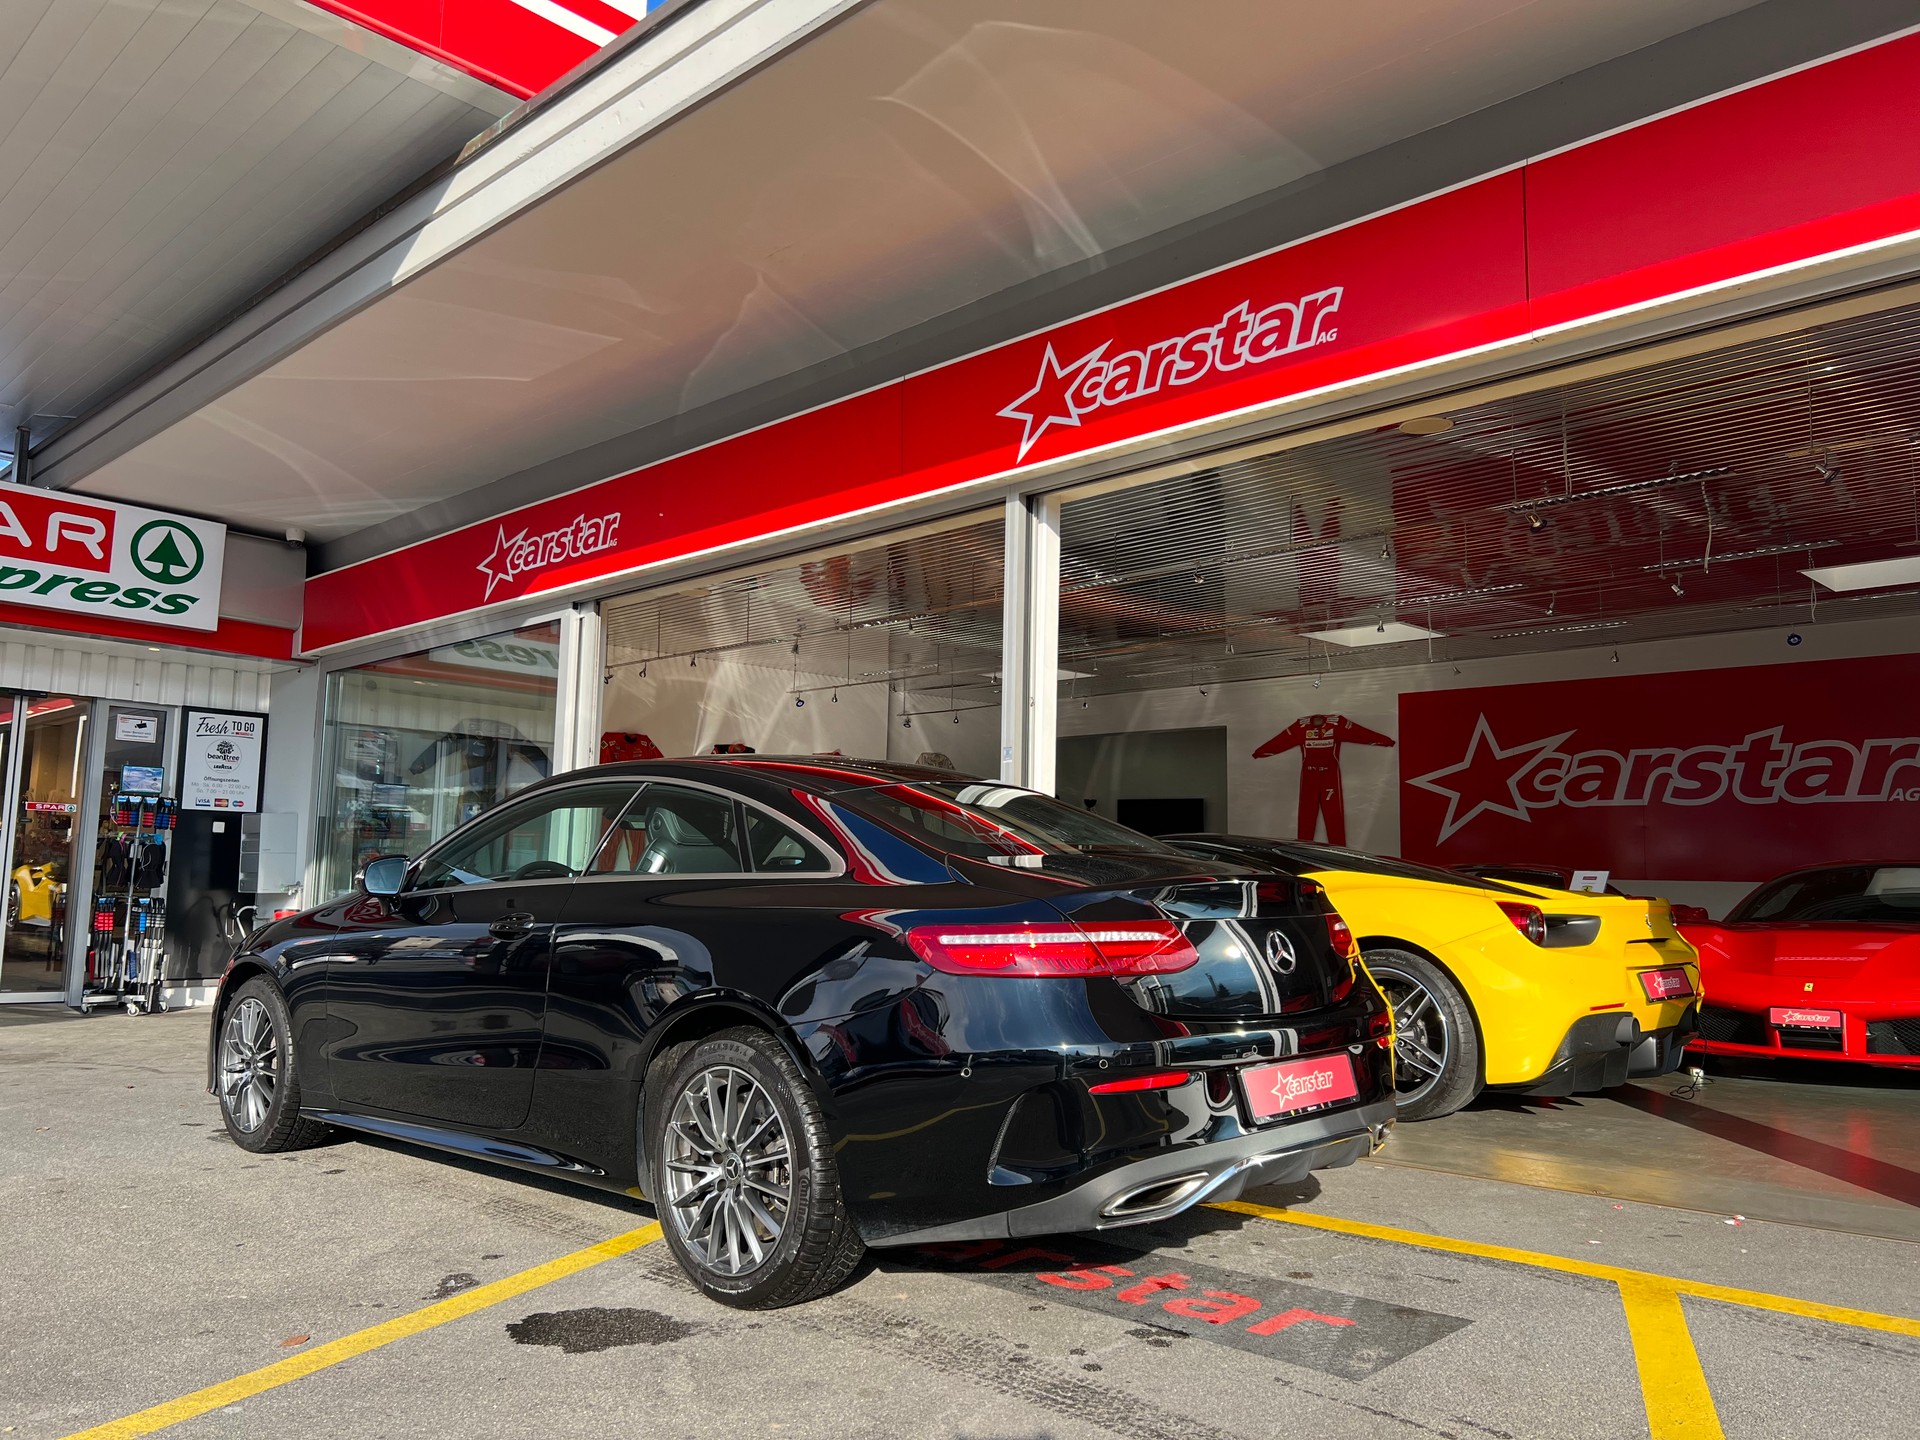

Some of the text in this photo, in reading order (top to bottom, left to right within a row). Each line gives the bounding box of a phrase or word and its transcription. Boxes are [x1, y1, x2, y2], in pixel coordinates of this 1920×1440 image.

[1068, 286, 1344, 414] carstar AG
[508, 512, 621, 574] carstar AG
[196, 716, 229, 734] Fresh
[232, 721, 242, 731] TO
[244, 722, 255, 732] GO
[1508, 725, 1920, 809] carstar AG
[35, 803, 66, 811] SPAR
[1326, 788, 1334, 800] 7
[1287, 1070, 1334, 1097] carstar
